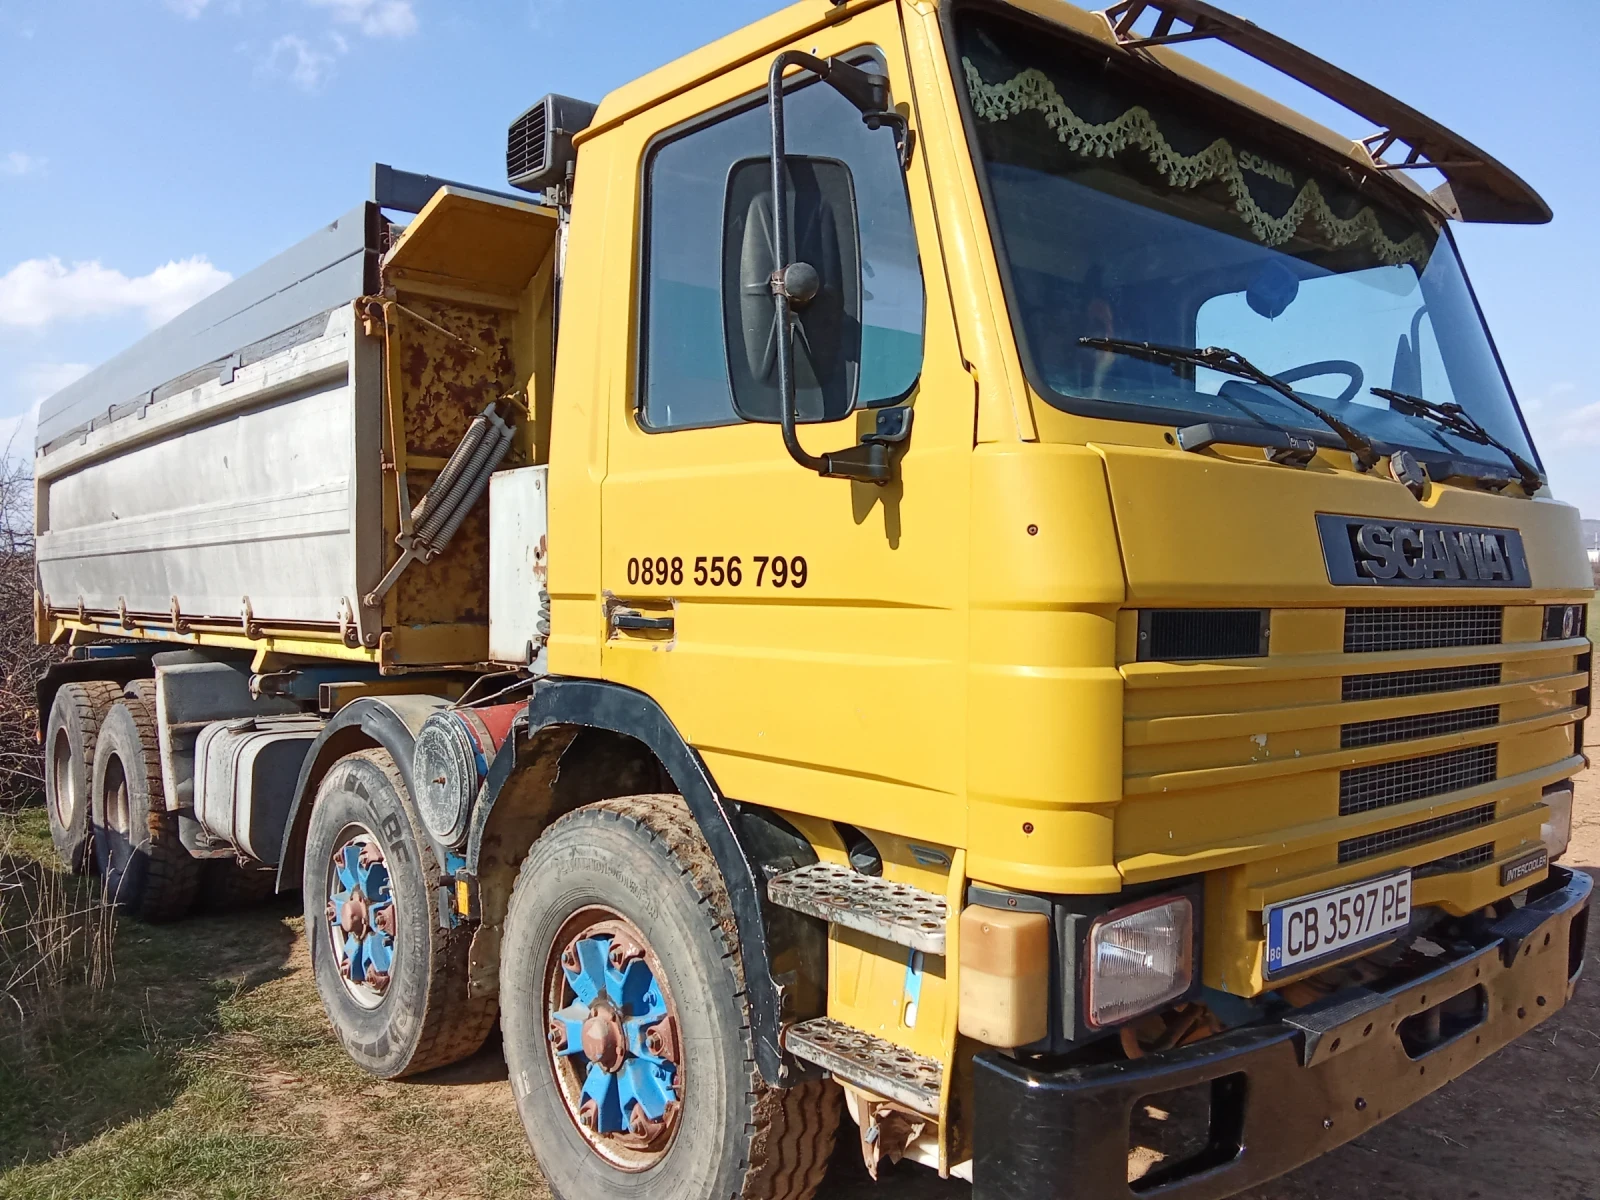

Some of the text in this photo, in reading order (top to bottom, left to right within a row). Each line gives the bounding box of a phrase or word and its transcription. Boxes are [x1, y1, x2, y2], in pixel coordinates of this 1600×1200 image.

[1239, 149, 1295, 188] SCANIA
[1356, 523, 1512, 581] SCANIA
[627, 556, 808, 589] 0898 556 799
[1506, 856, 1547, 882] INTERCOOLER
[1324, 888, 1380, 945] 3597
[1270, 945, 1282, 961] BG
